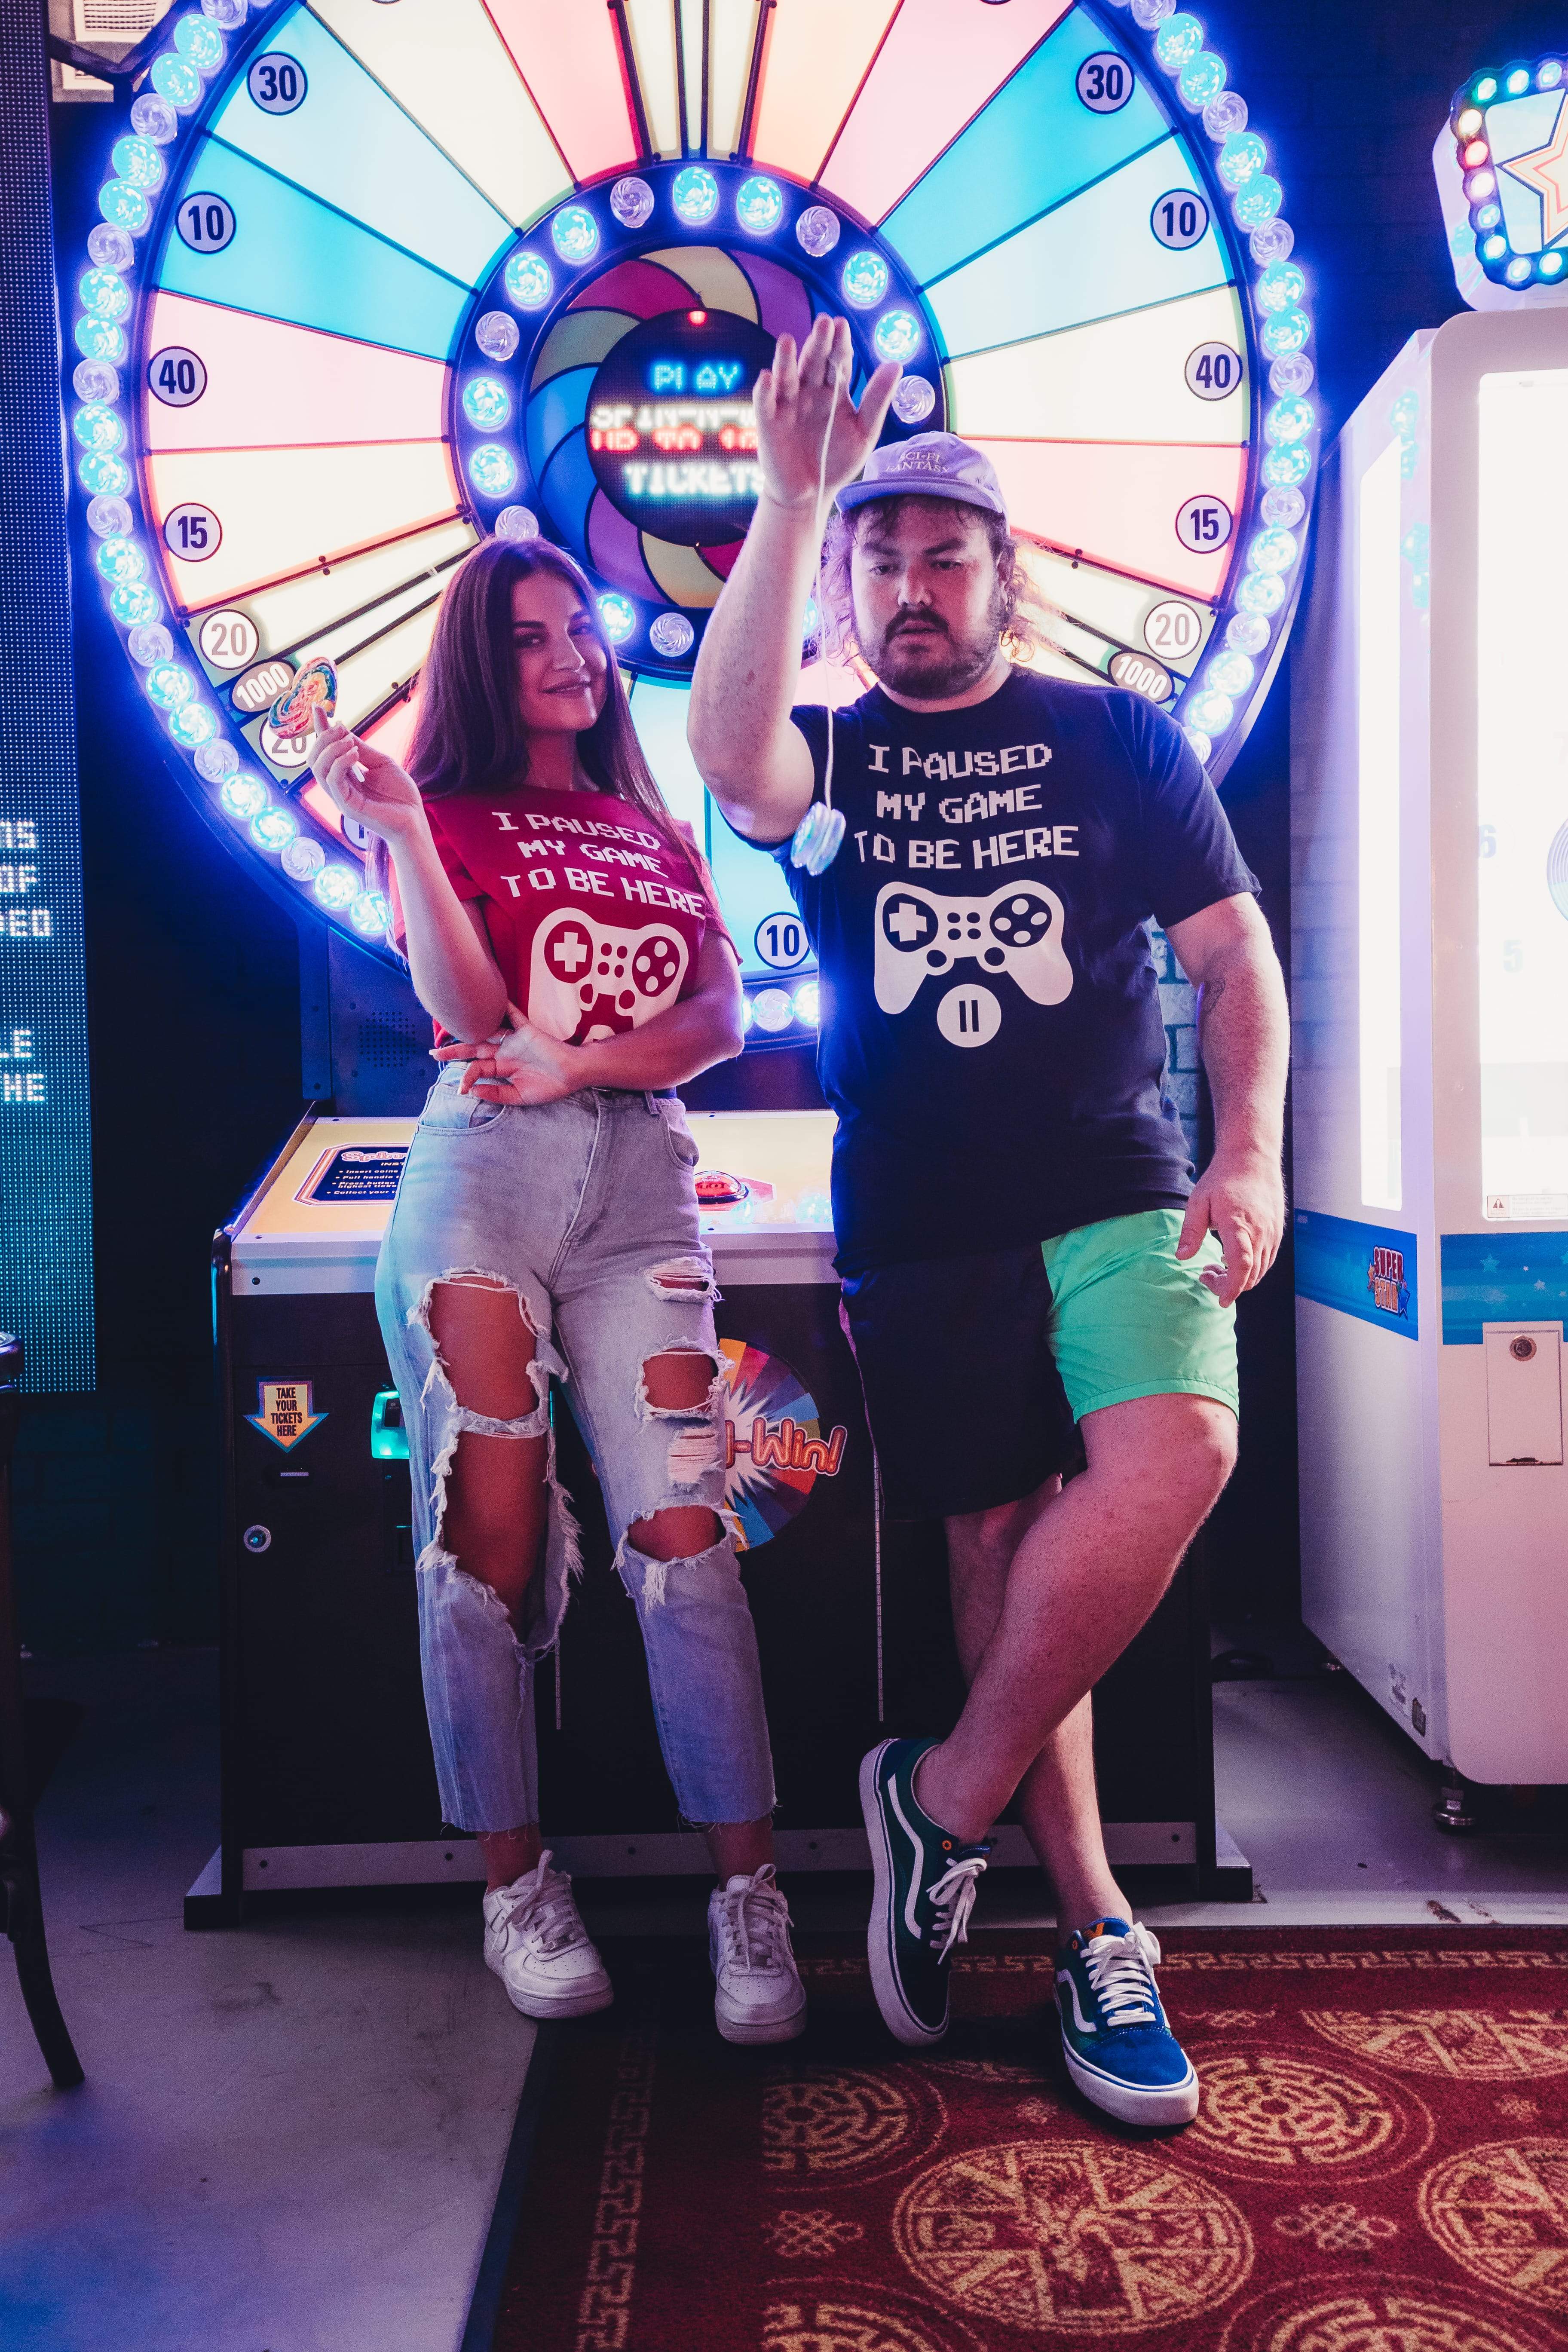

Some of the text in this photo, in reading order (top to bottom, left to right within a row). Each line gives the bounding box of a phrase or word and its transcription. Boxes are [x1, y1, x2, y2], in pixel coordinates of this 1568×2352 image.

[259, 65, 297, 101] 30
[1086, 64, 1123, 101] 30
[188, 205, 224, 242] 10
[1162, 202, 1196, 237] 10
[159, 359, 195, 394] 40
[1196, 354, 1231, 388] 40
[178, 516, 208, 548] 15
[1190, 508, 1219, 540] 15
[211, 623, 247, 656] 20
[1155, 613, 1190, 646] 20
[236, 663, 290, 709] 1000
[1115, 655, 1168, 699] 1000
[868, 743, 1052, 781] I PAUSED
[877, 784, 1042, 824] MY GAME
[491, 812, 662, 850] I PAUSED
[854, 826, 1079, 869] TO BE HERE
[517, 839, 669, 878] MY GAME
[500, 867, 706, 920] TO BE HERE
[766, 924, 799, 956] 10
[1374, 1246, 1403, 1282] SUPER
[1375, 1277, 1399, 1314] STAR
[276, 1387, 296, 1399] TAKE
[276, 1400, 297, 1412] YOUR
[270, 1412, 303, 1424] TICKETS
[277, 1424, 297, 1436] HERE
